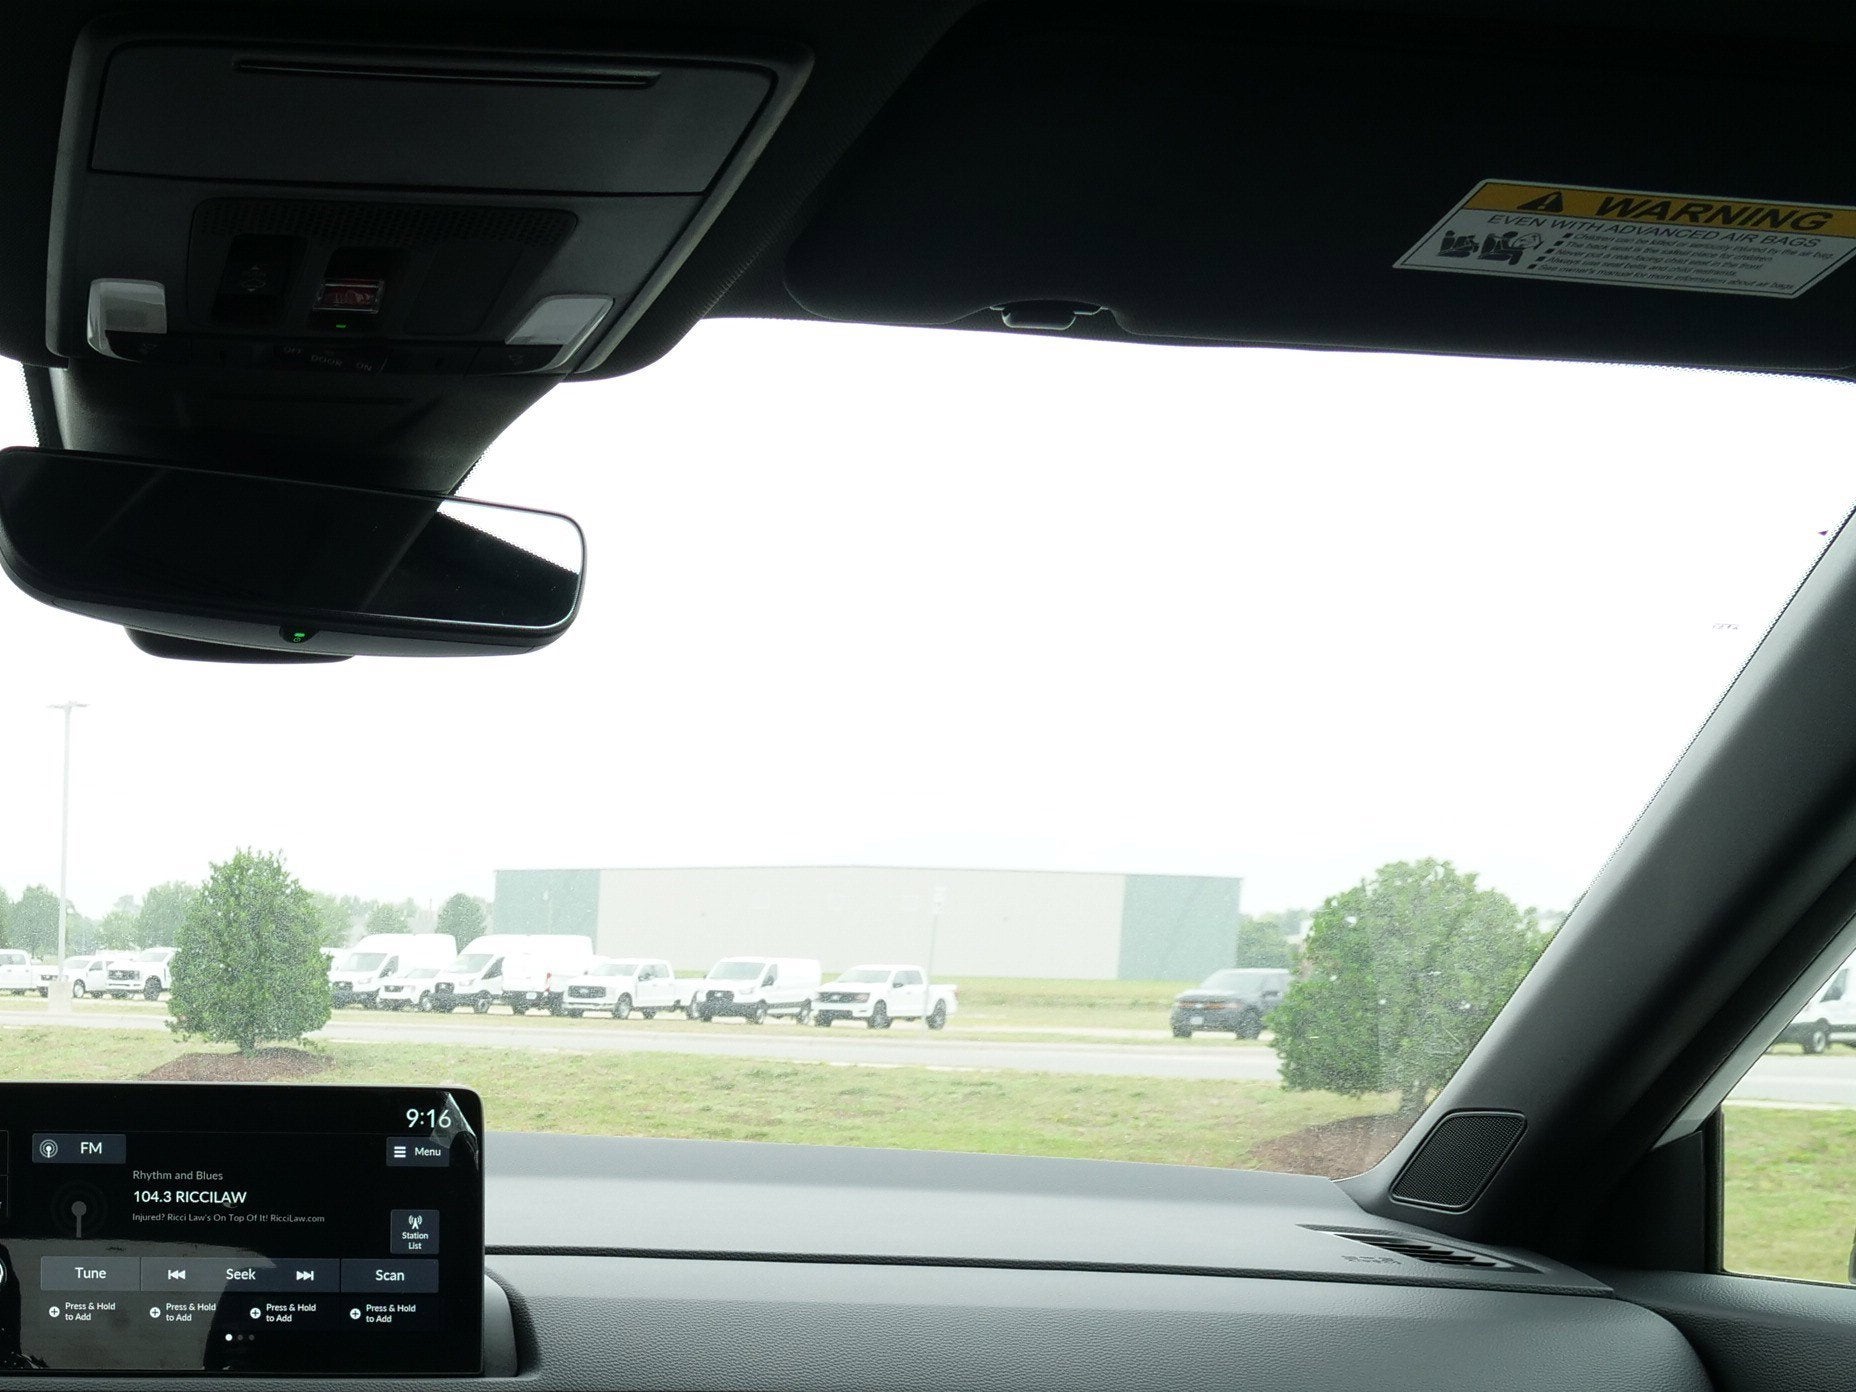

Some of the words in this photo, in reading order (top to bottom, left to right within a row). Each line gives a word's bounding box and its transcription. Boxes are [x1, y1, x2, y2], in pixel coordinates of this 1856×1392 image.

[1595, 197, 1834, 231] WARNING
[1488, 214, 1547, 227] EVEN
[1550, 219, 1605, 231] WITH
[1603, 224, 1720, 241] ADVANCED
[1720, 232, 1759, 243] AIR
[1760, 235, 1822, 248] BAGS
[406, 1108, 452, 1128] 9:16
[80, 1141, 103, 1154] FM
[414, 1147, 442, 1157] Menu
[132, 1170, 172, 1181] Rhythm
[175, 1170, 193, 1180] and
[196, 1170, 224, 1180] Blues
[133, 1190, 172, 1203] 104.3
[176, 1191, 247, 1204] RICCILAW
[132, 1213, 165, 1222] Injured?
[167, 1213, 186, 1221] Ricci
[188, 1214, 211, 1222] Law's
[213, 1214, 226, 1222] On
[228, 1214, 244, 1223] Top
[246, 1214, 258, 1222] Of
[259, 1214, 269, 1222] It!
[271, 1214, 325, 1223] RicciLaw.com
[402, 1231, 429, 1240] Station
[408, 1242, 422, 1250] List
[74, 1267, 107, 1279] Tune
[226, 1268, 256, 1280] Seek
[375, 1270, 405, 1281] Scan
[65, 1302, 86, 1311] Press
[88, 1302, 94, 1311] &
[97, 1302, 116, 1311] Hold
[166, 1303, 186, 1312] Press
[188, 1303, 195, 1312] &
[197, 1303, 216, 1312] Hold
[266, 1303, 287, 1312] Press
[289, 1303, 295, 1312] &
[297, 1303, 316, 1312] Hold
[366, 1304, 387, 1313] Press
[388, 1304, 395, 1313] &
[397, 1304, 416, 1313] Hold
[65, 1313, 74, 1321] to
[75, 1313, 92, 1321] Add
[166, 1314, 174, 1322] to
[176, 1314, 192, 1322] Add
[266, 1314, 275, 1322] to
[276, 1314, 292, 1322] Add
[366, 1315, 375, 1323] to
[376, 1315, 392, 1323] Add
